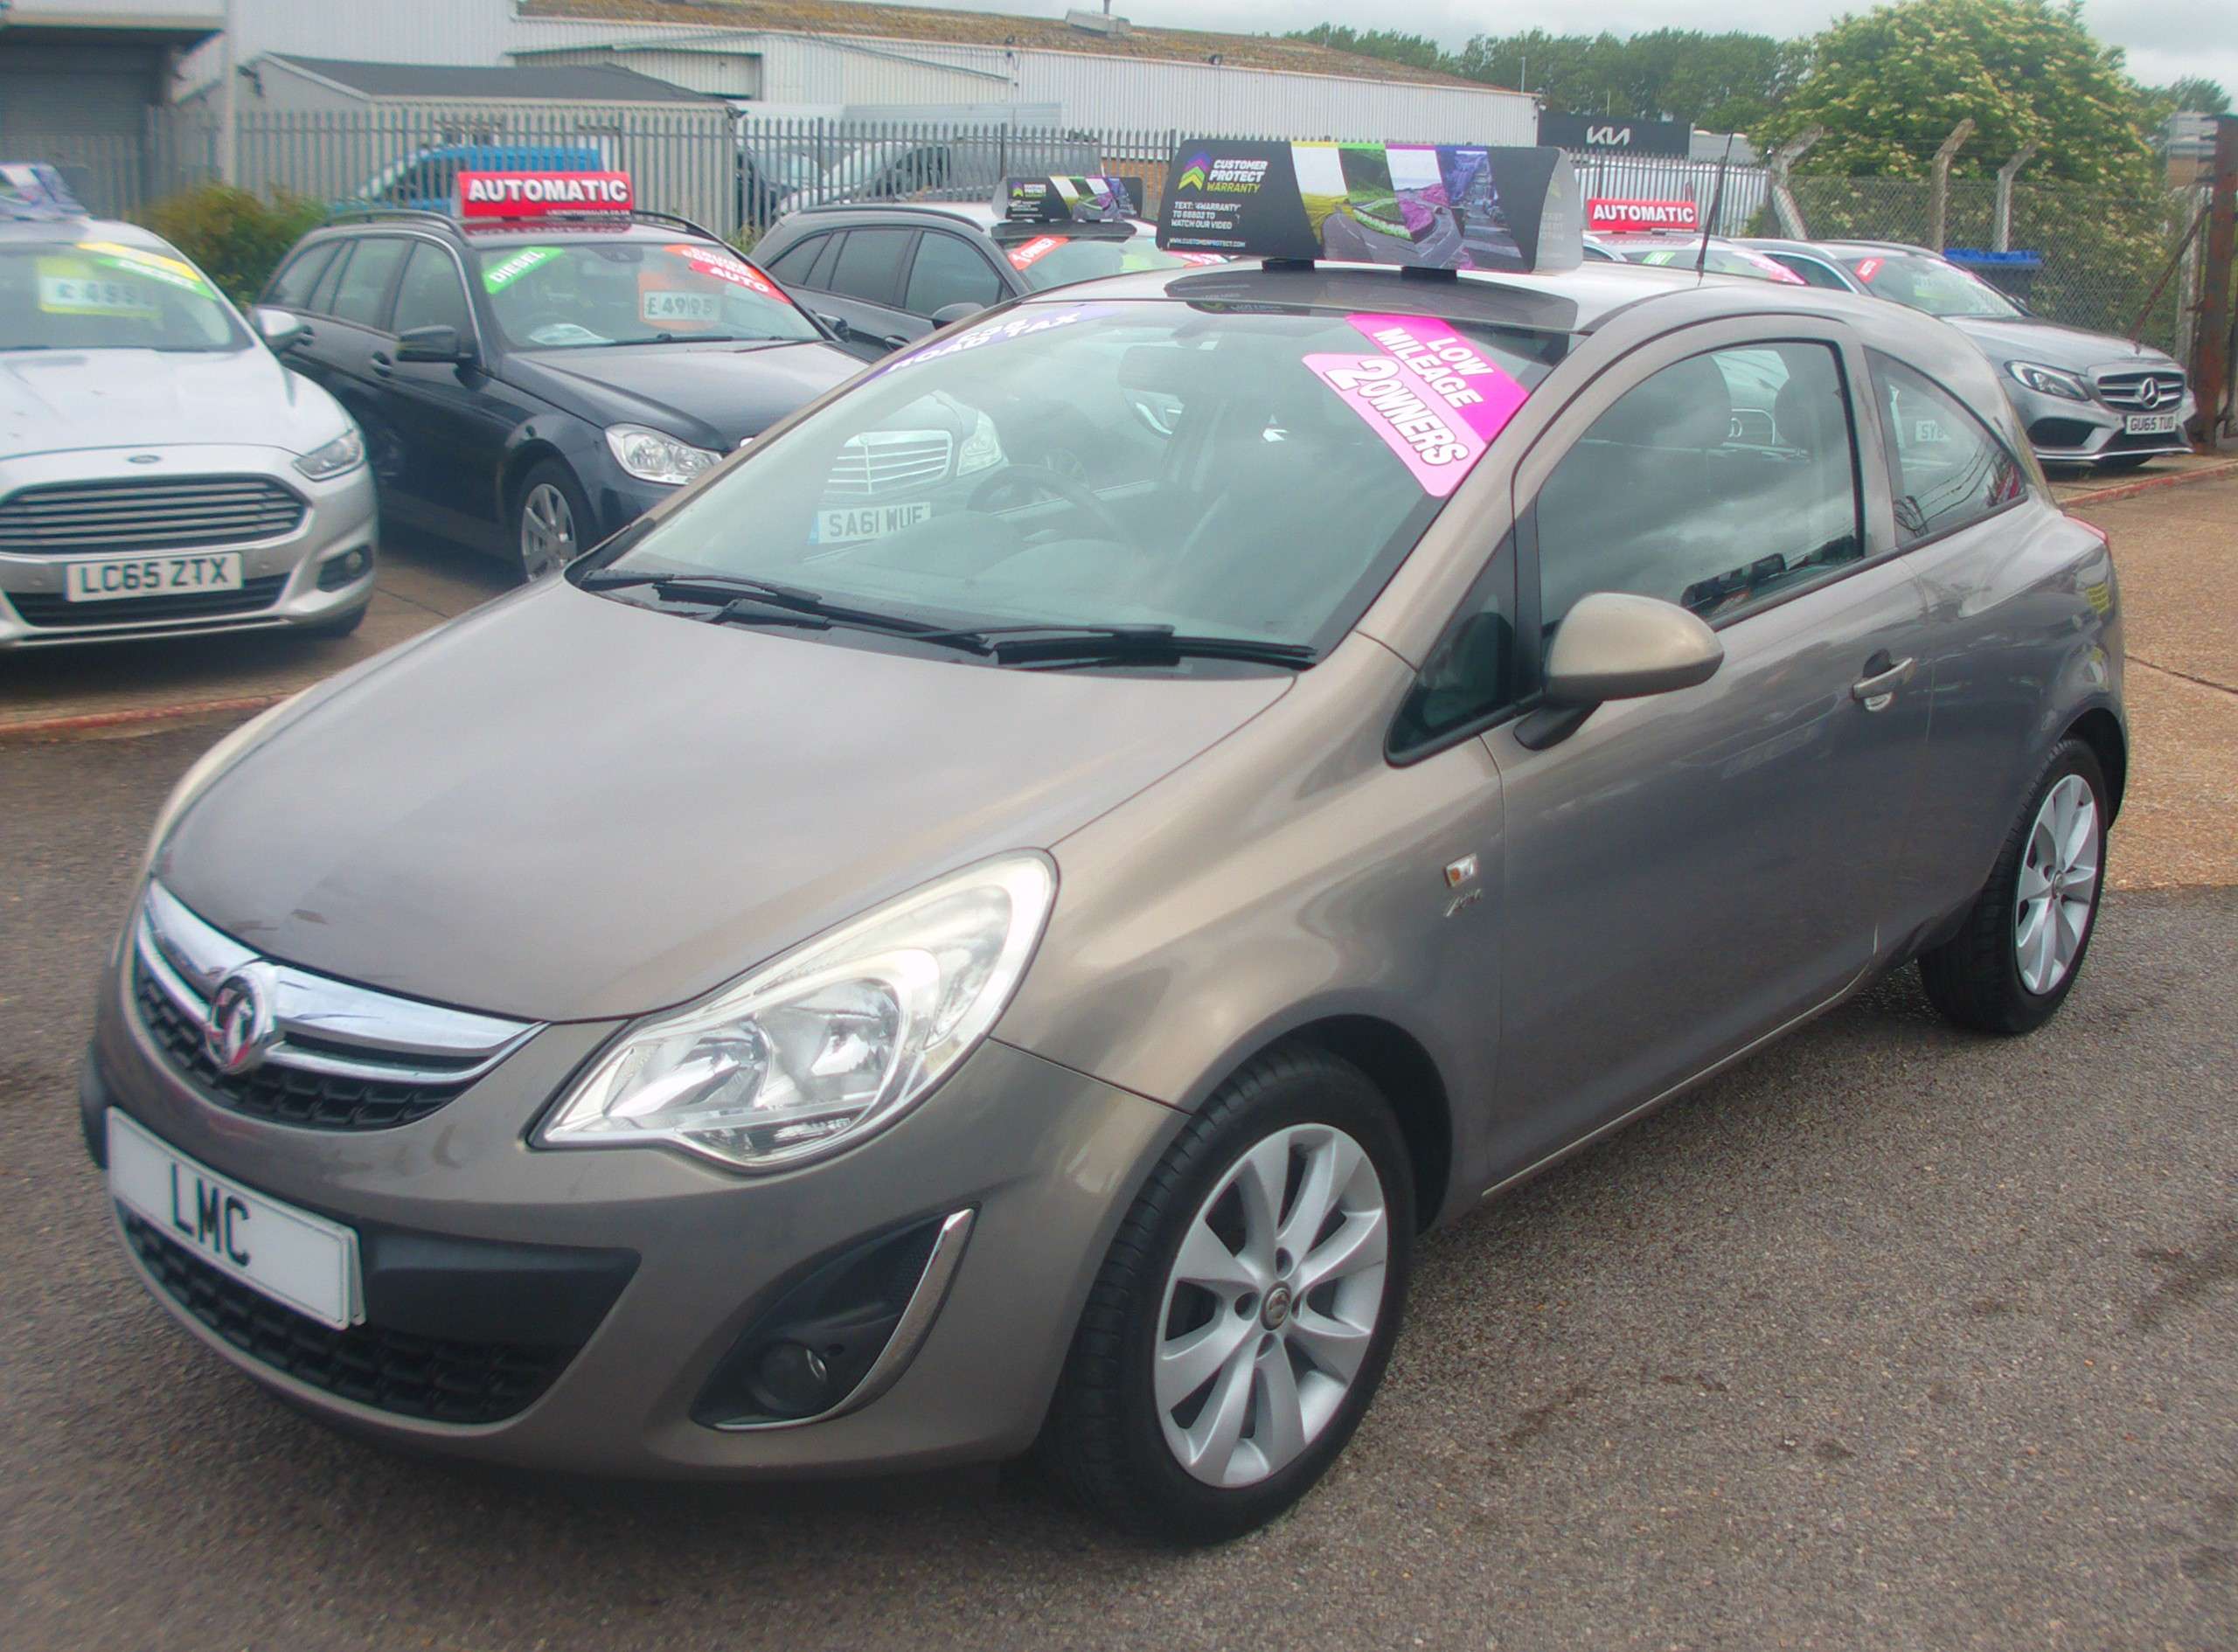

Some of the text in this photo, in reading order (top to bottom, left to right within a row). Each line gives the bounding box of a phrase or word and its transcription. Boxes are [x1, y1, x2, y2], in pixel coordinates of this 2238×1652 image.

[1209, 170, 1265, 183] PROTECT
[1213, 159, 1268, 170] CUSTOMER
[468, 178, 629, 202] AUTOMATIC
[1206, 182, 1260, 193] WARRANTY
[1172, 210, 1181, 219] TO
[1206, 212, 1216, 220] TO
[1174, 201, 1193, 210] TEXT:
[1593, 205, 1694, 223] AUTOMATIC
[1171, 219, 1233, 230] WATCH OUR VIDEO
[709, 266, 769, 293] AUTO
[1004, 312, 1082, 337] TAX
[1373, 327, 1484, 409] MILEAGE
[1426, 337, 1495, 376] LOW
[1357, 378, 1470, 466] OWNERS
[829, 510, 879, 538] SA61
[80, 557, 229, 594] LC65 ZTX
[170, 1161, 251, 1267] LMC
